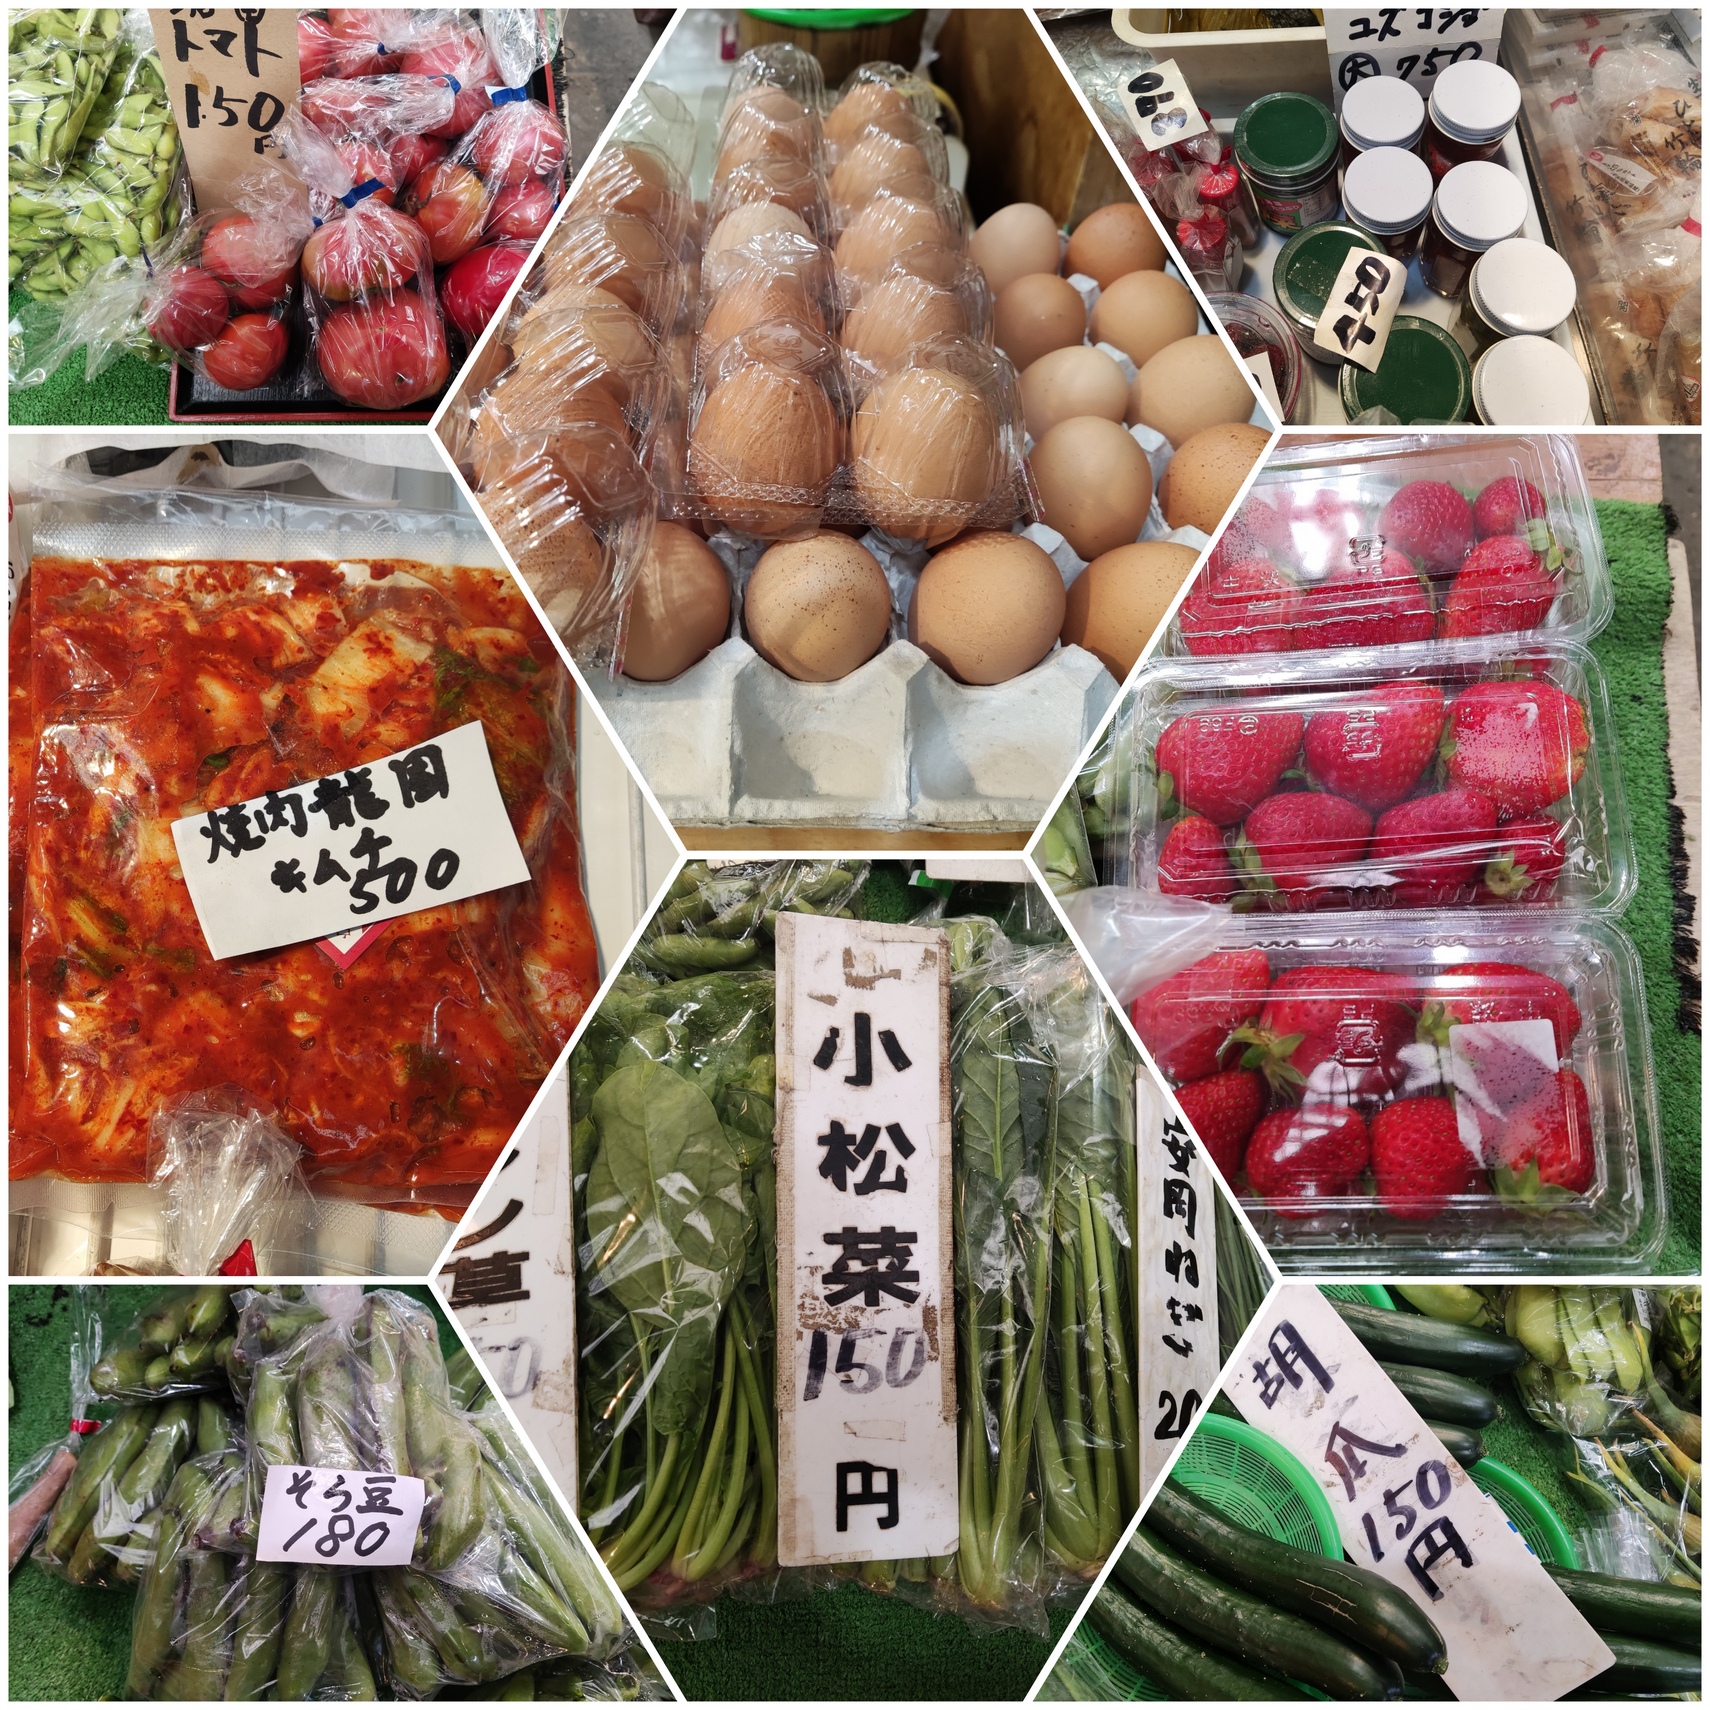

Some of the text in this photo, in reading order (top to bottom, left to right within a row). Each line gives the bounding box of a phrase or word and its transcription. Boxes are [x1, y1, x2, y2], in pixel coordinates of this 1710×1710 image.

[172, 19, 283, 78] トマト
[1332, 256, 1391, 354] 450
[271, 827, 392, 893] キムチ
[350, 848, 460, 914] 500
[803, 1012, 929, 1533] 小松菜 150 円
[286, 1469, 404, 1516] そら豆
[1252, 1319, 1476, 1602] 胡瓜 150 円
[282, 1513, 391, 1558] 180
